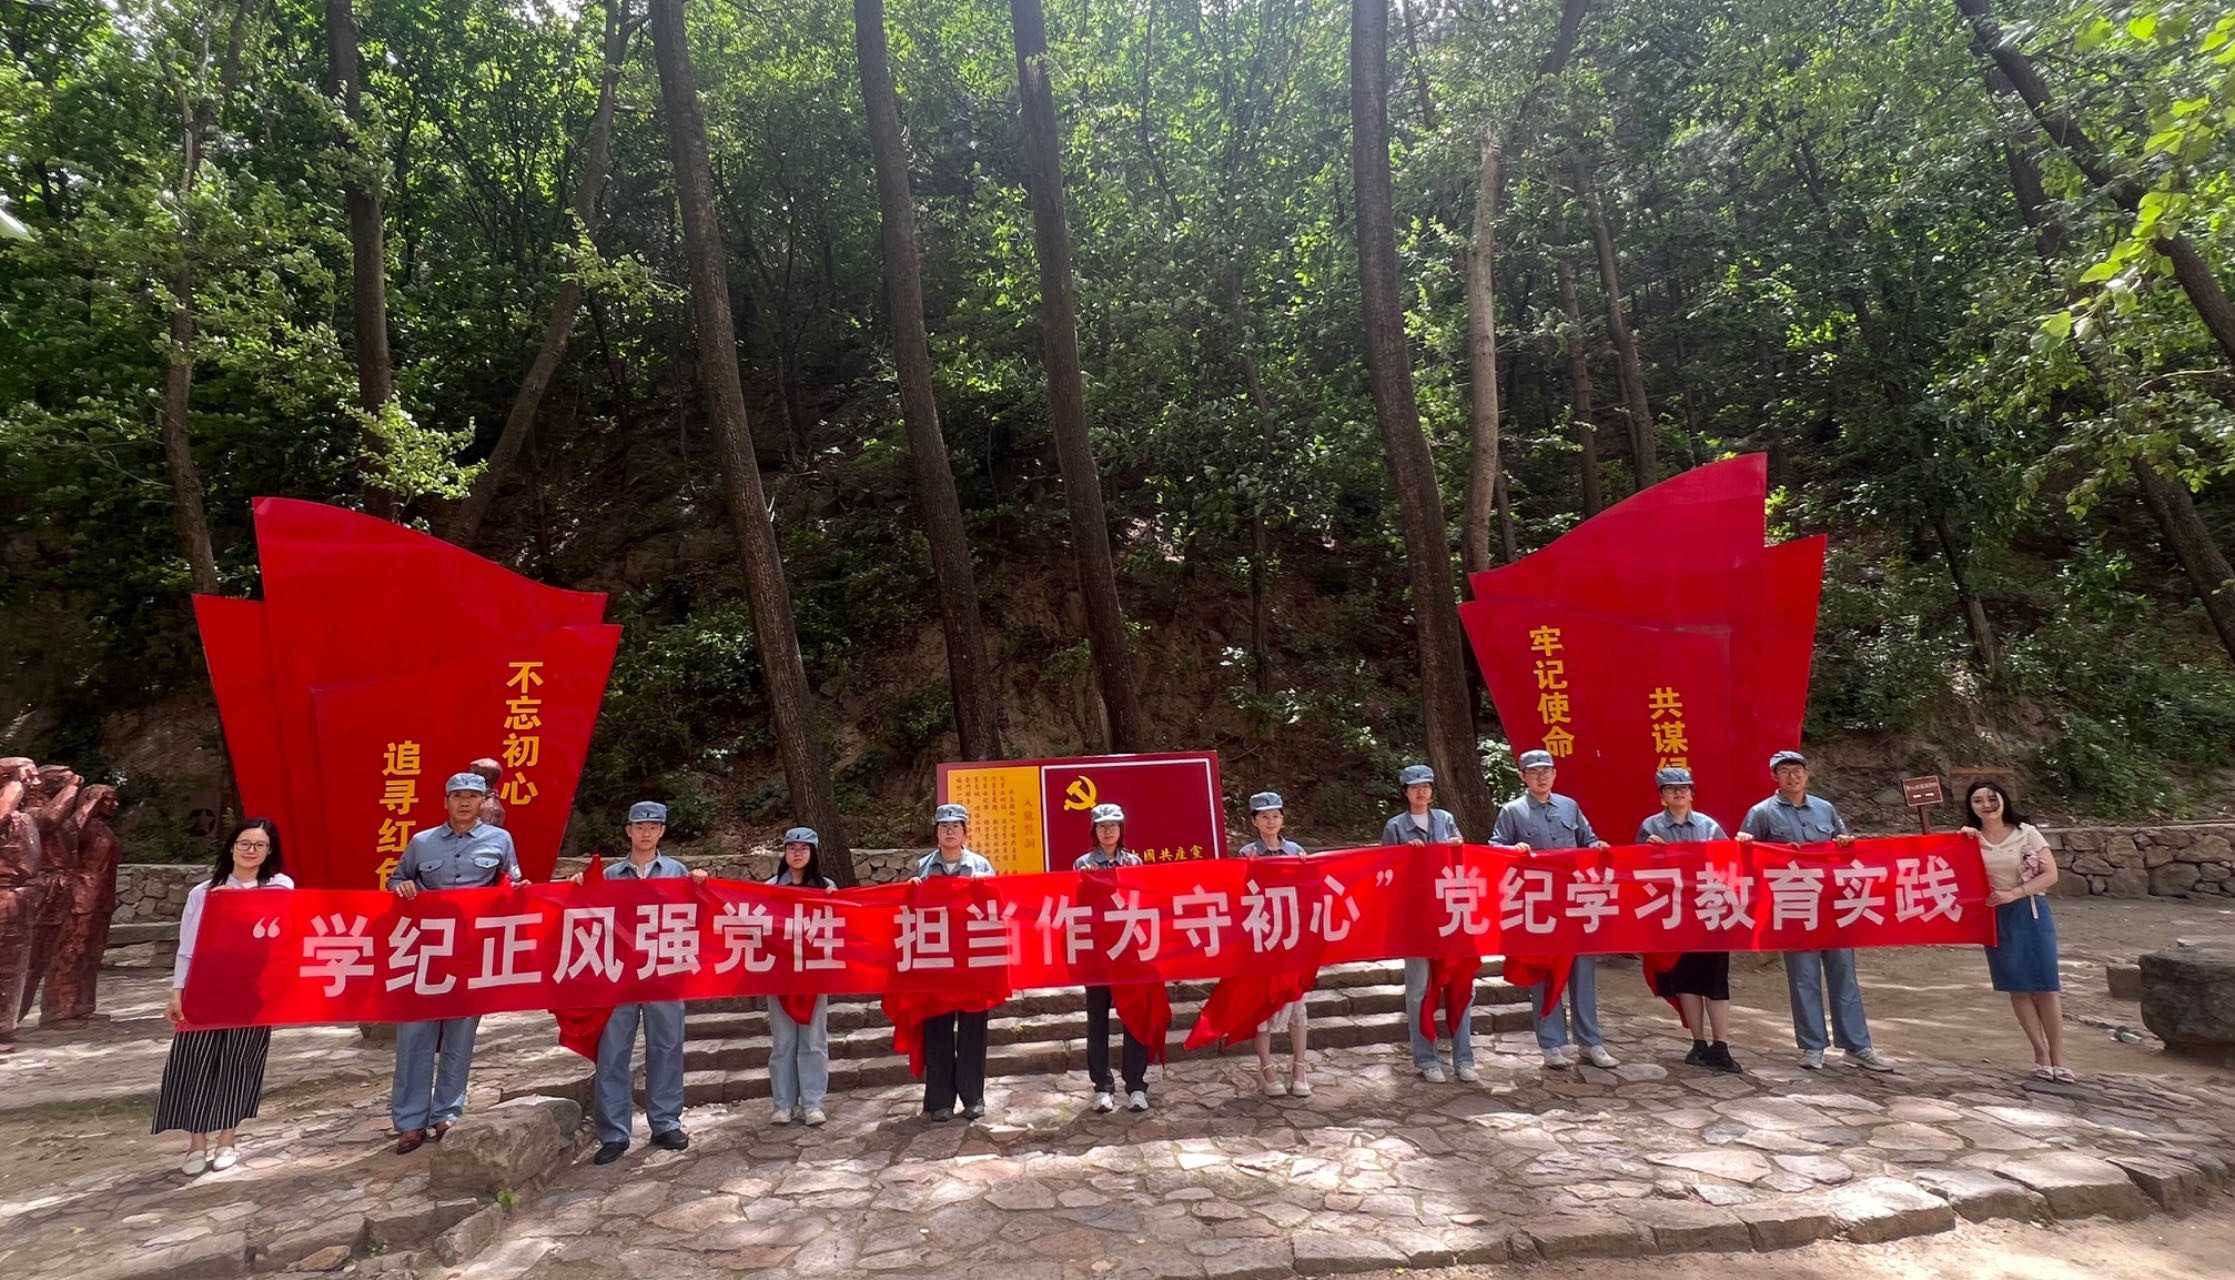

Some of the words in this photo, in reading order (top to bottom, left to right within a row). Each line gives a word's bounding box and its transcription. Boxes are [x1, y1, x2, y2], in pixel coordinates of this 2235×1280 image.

[500, 661, 544, 806] 不忘初心
[1529, 625, 1575, 758] 牢记使命
[252, 902, 847, 998] “学纪正风强党性
[893, 868, 1395, 973] 担当作为守初心”
[1434, 854, 1963, 938] 党纪学习教育实践
